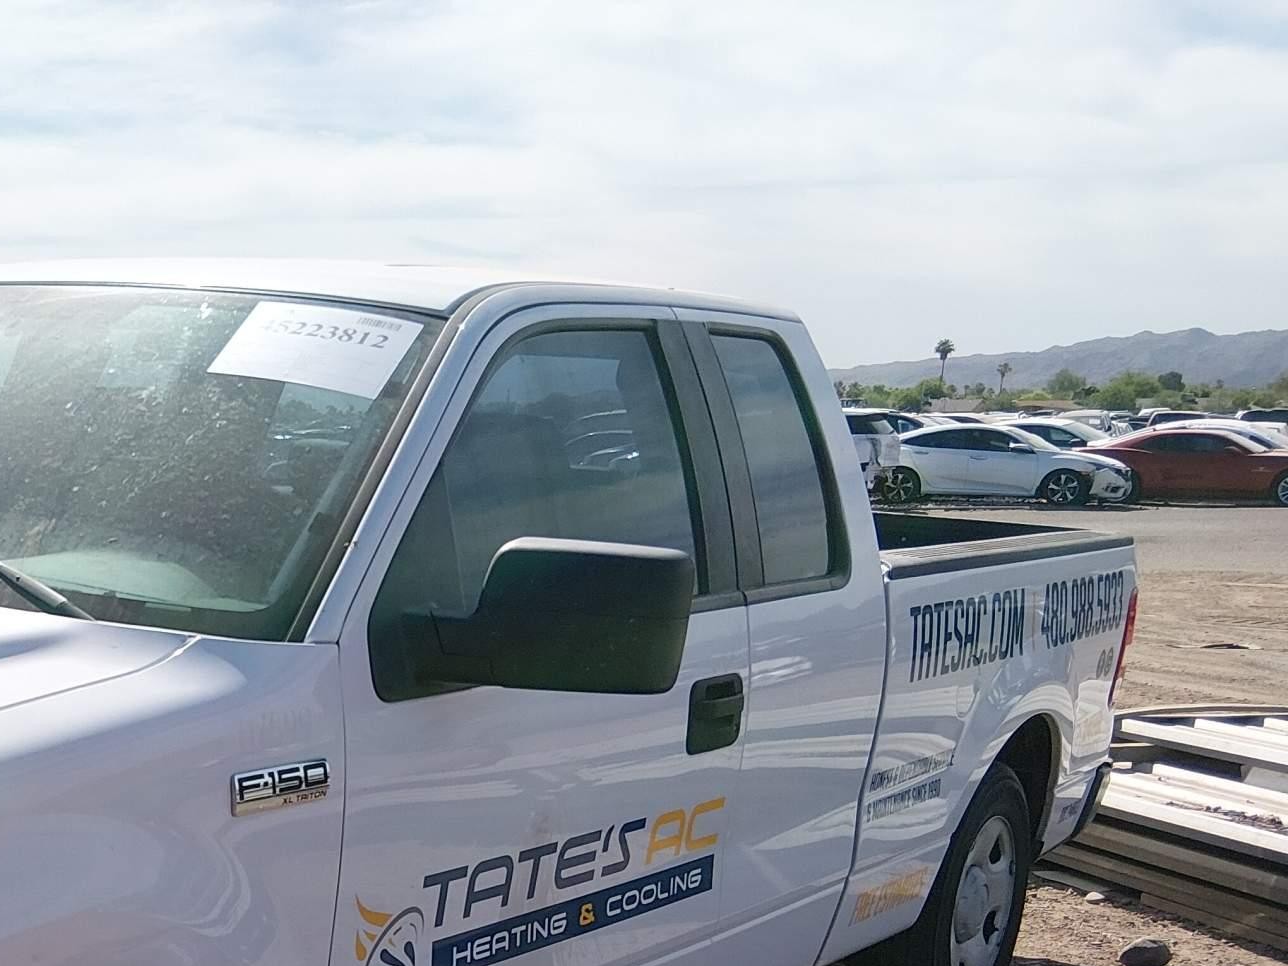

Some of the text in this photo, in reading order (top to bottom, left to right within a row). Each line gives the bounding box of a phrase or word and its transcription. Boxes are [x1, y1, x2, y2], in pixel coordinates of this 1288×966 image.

[909, 570, 1124, 683] TATESAC.COM 480.988.5933
[237, 762, 329, 801] F-150
[282, 790, 327, 806] XL TRITON
[422, 796, 727, 928] TATE'S AC
[578, 903, 595, 927] &
[606, 868, 702, 917] COOLING
